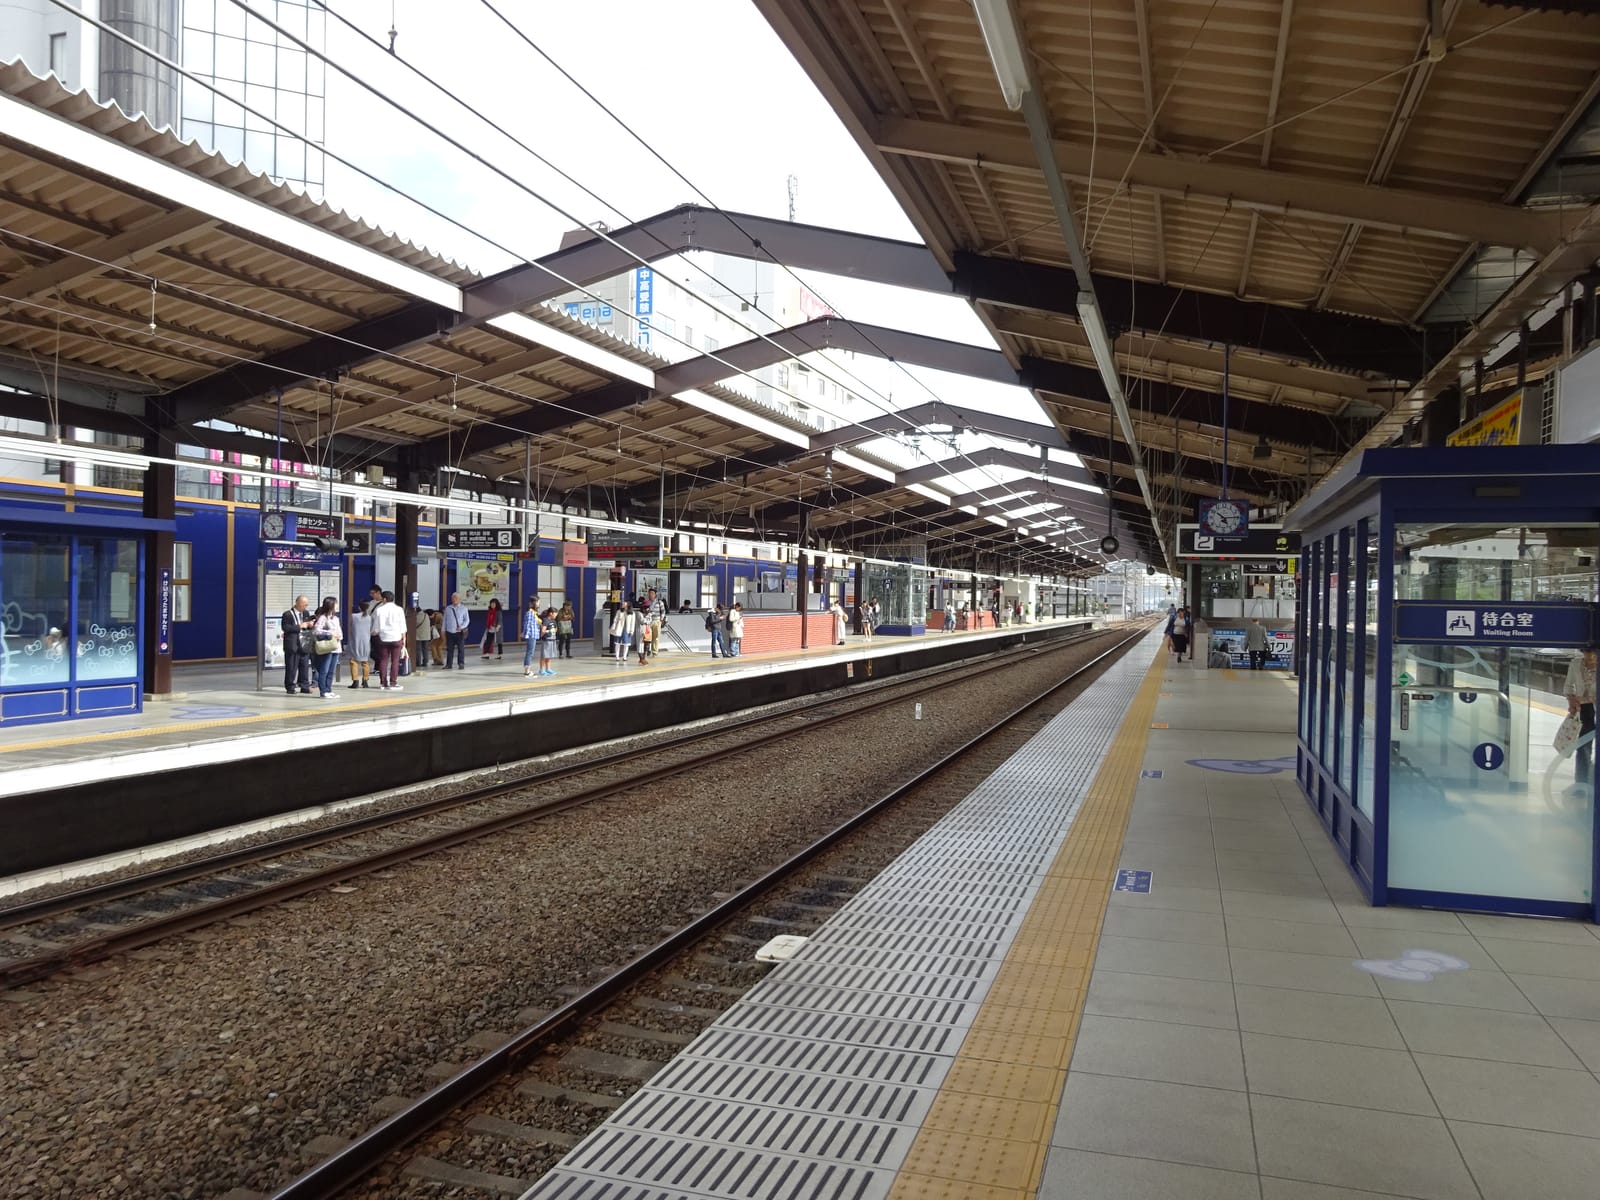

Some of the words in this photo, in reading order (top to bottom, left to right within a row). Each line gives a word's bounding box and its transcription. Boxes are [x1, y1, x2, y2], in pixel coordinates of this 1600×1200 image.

[639, 317, 649, 349] en
[296, 516, 328, 526] 多摩センター
[499, 532, 510, 546] 3
[1197, 534, 1211, 549] 2
[1482, 611, 1534, 627] 待合室
[1483, 629, 1511, 637] Waiting
[1511, 629, 1534, 637] Room
